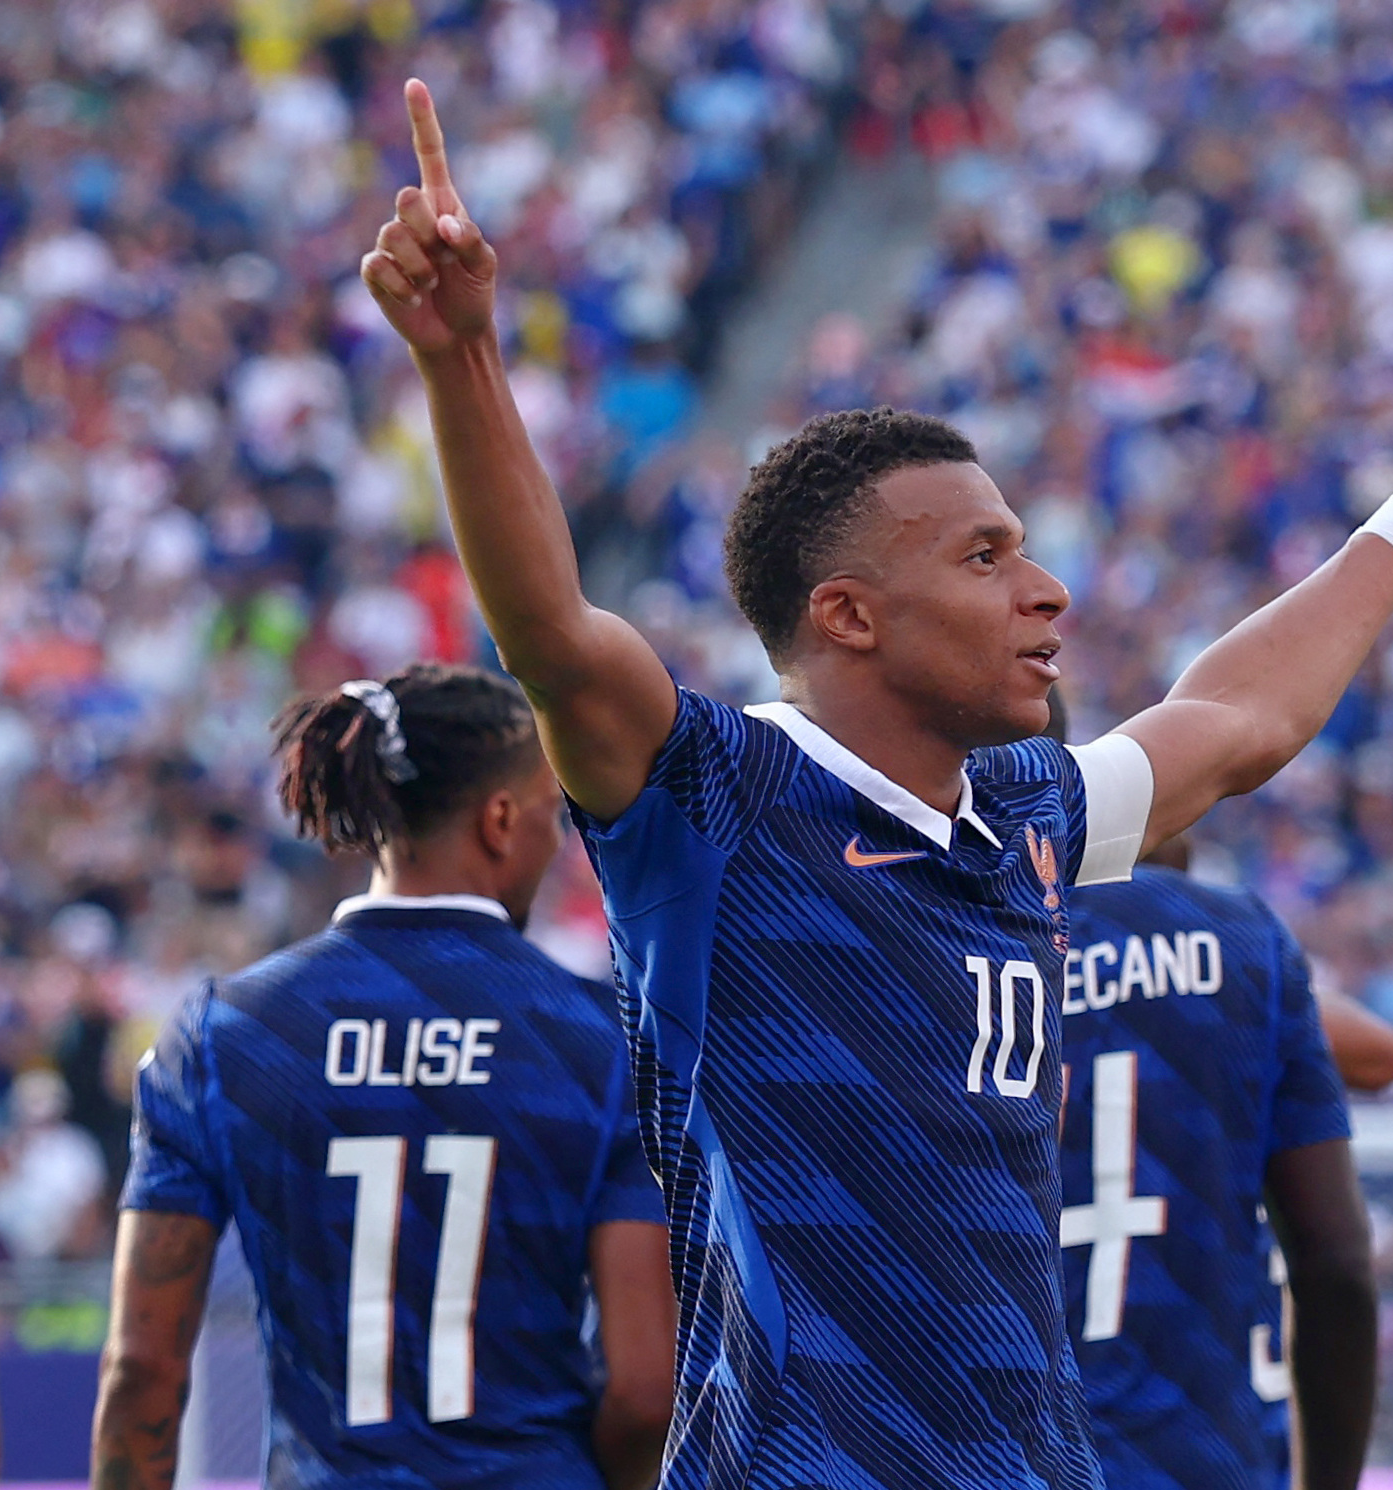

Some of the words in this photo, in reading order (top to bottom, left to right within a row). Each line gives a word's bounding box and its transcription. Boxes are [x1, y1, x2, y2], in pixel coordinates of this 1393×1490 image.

[324, 1018, 502, 1087] OLISE
[965, 955, 1044, 1099] 10
[325, 1135, 498, 1427] 11
